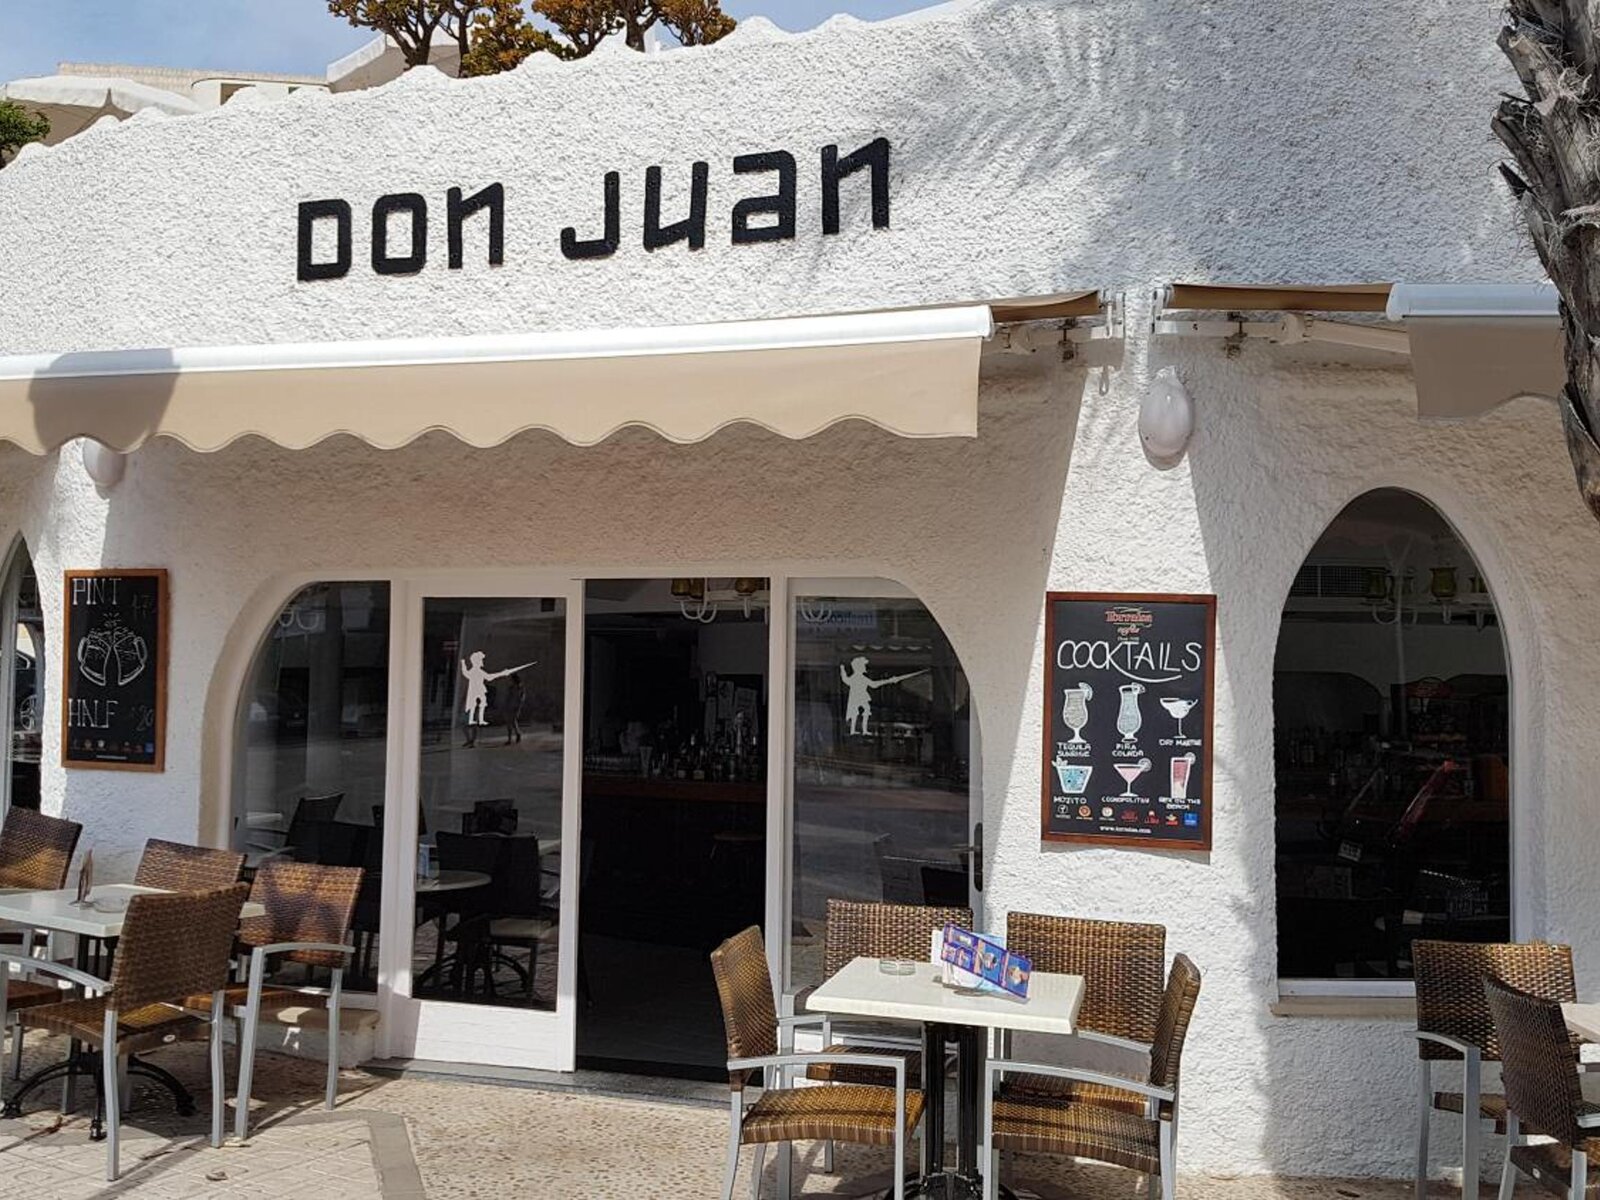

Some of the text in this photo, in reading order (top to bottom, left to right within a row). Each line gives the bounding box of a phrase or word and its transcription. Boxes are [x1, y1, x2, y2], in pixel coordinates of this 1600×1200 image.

[72, 577, 122, 605] PINT
[1057, 640, 1202, 682] COCKTAILS
[68, 698, 119, 729] HALF
[1057, 742, 1091, 750] TEQUILA
[1053, 796, 1087, 804] MOJITO
